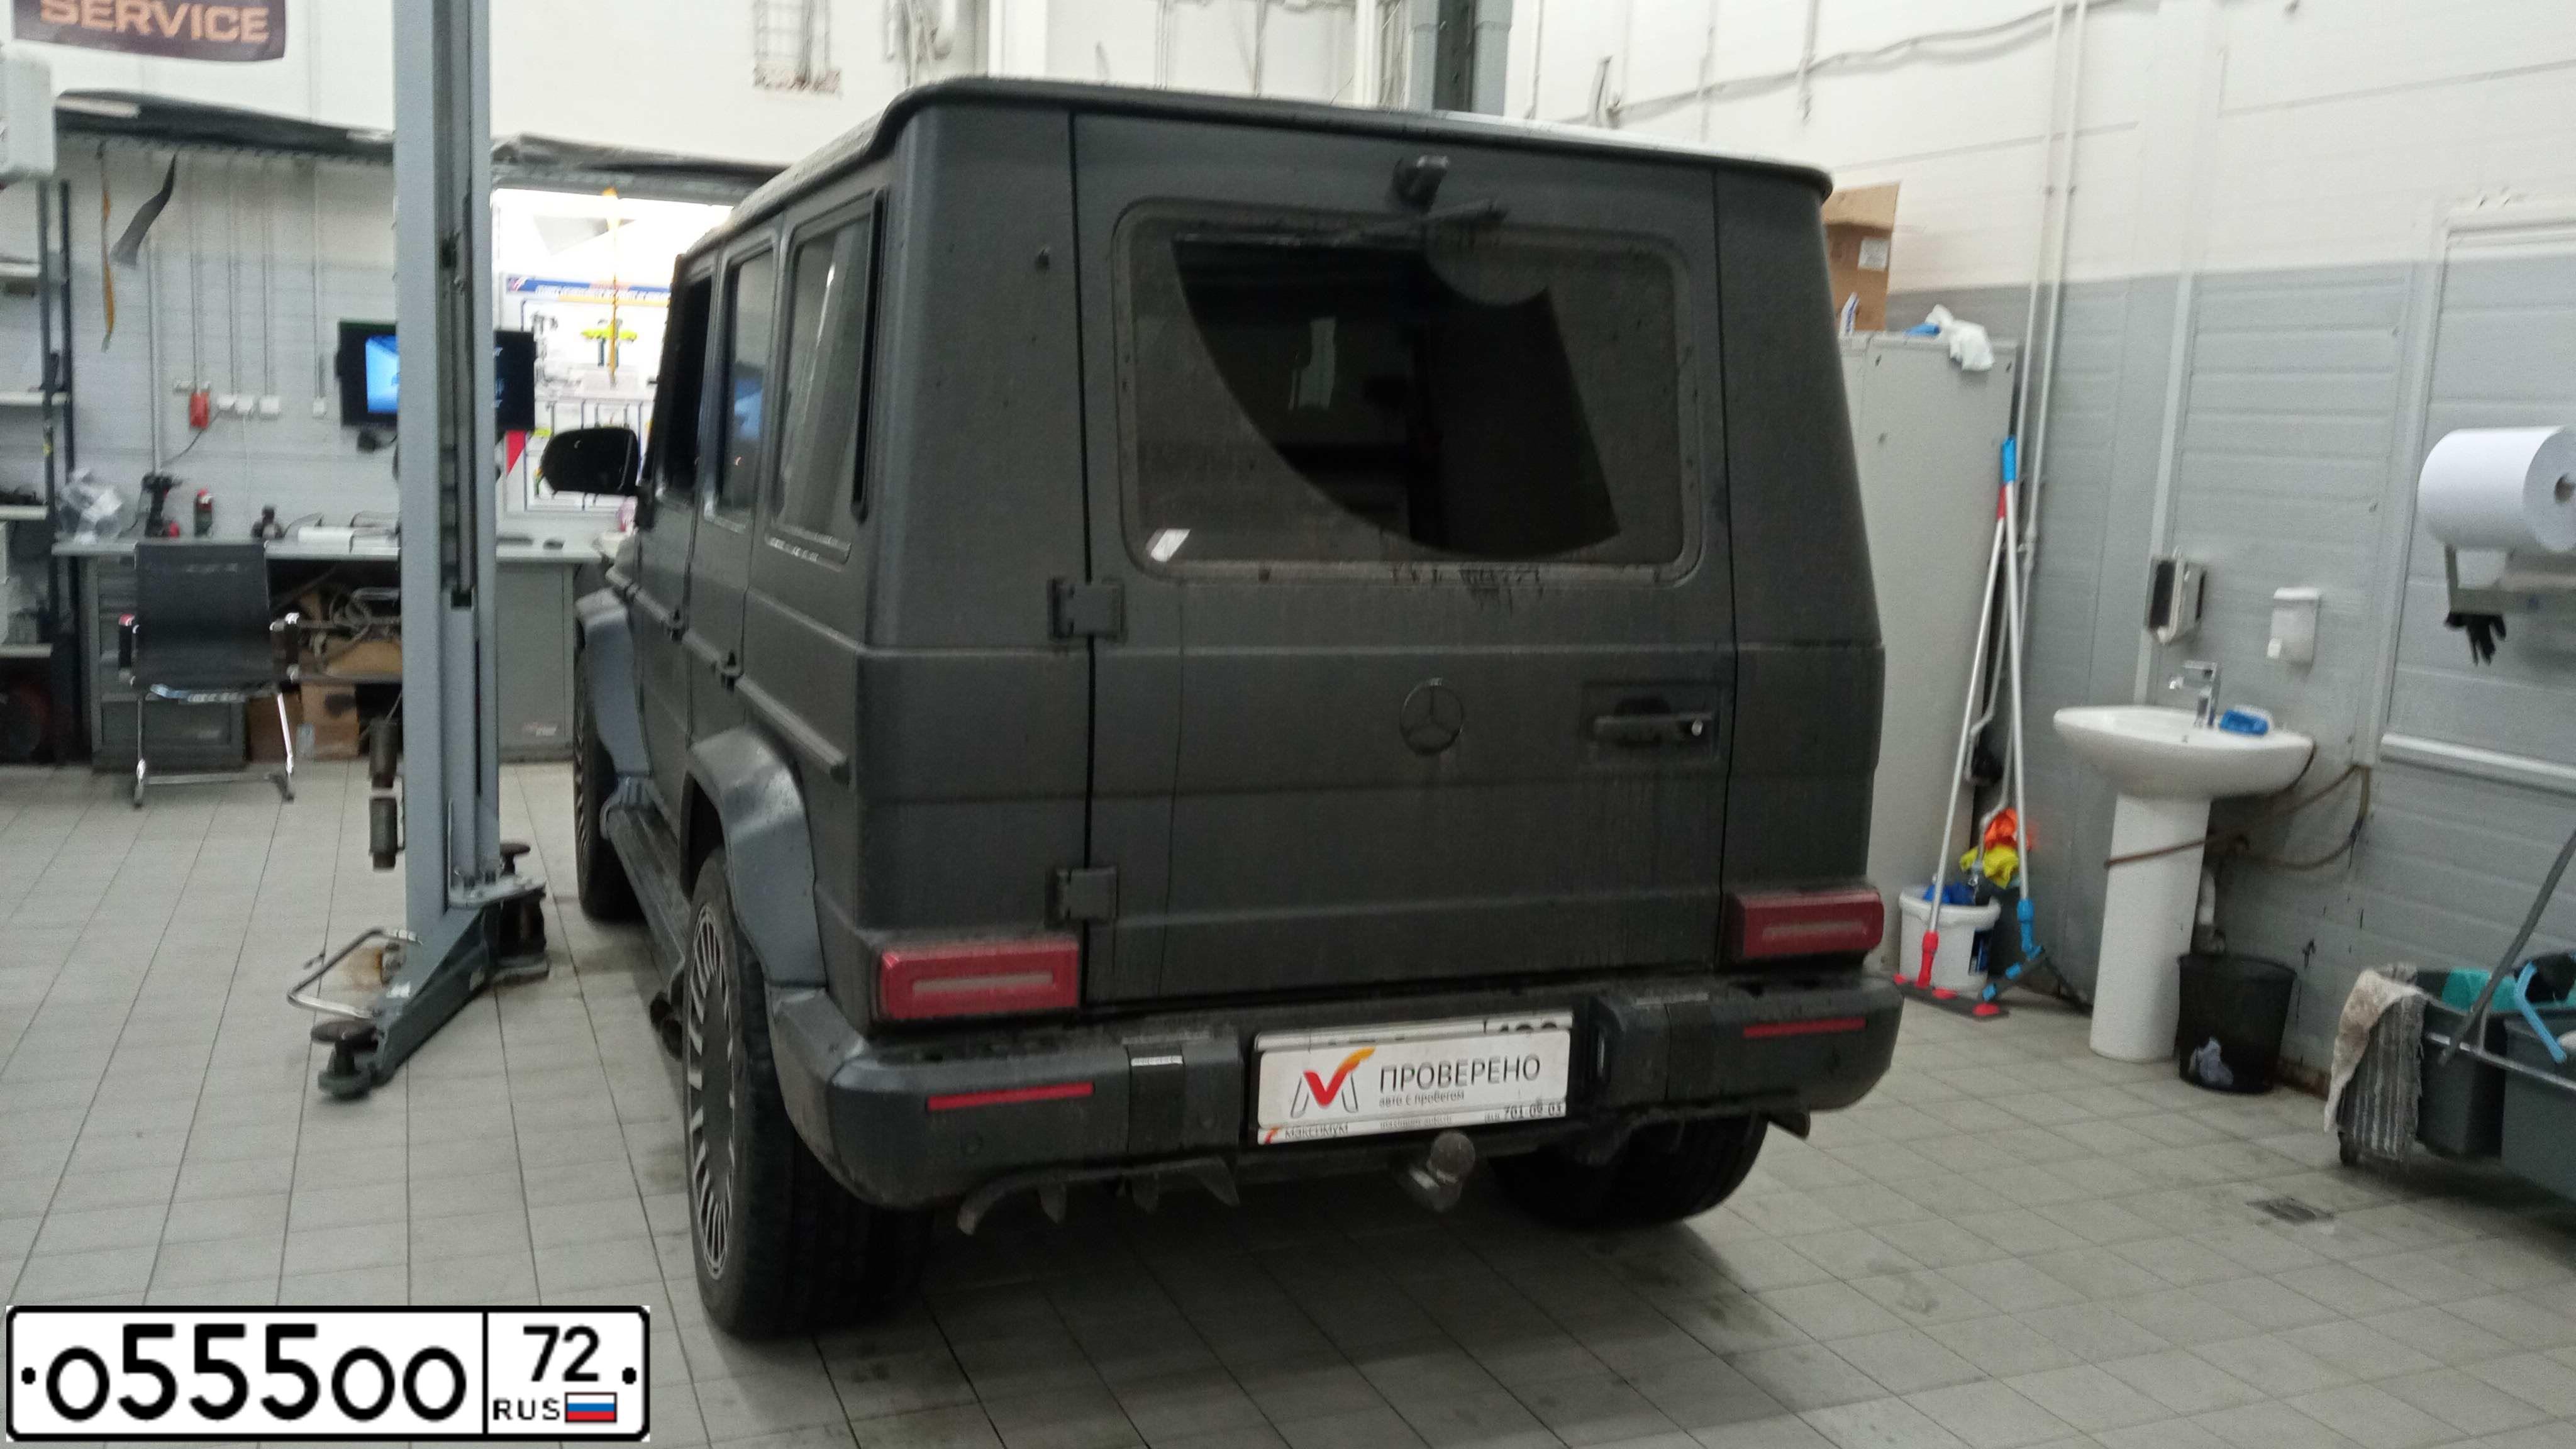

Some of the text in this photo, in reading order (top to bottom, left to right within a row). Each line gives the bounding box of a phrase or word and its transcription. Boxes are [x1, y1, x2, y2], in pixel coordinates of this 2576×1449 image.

[40, 0, 270, 43] SERVICE
[1379, 1055, 1541, 1092] ПРОВЕРЕНО
[1379, 1095, 1402, 1108] авто
[1414, 1089, 1465, 1106] пробегом
